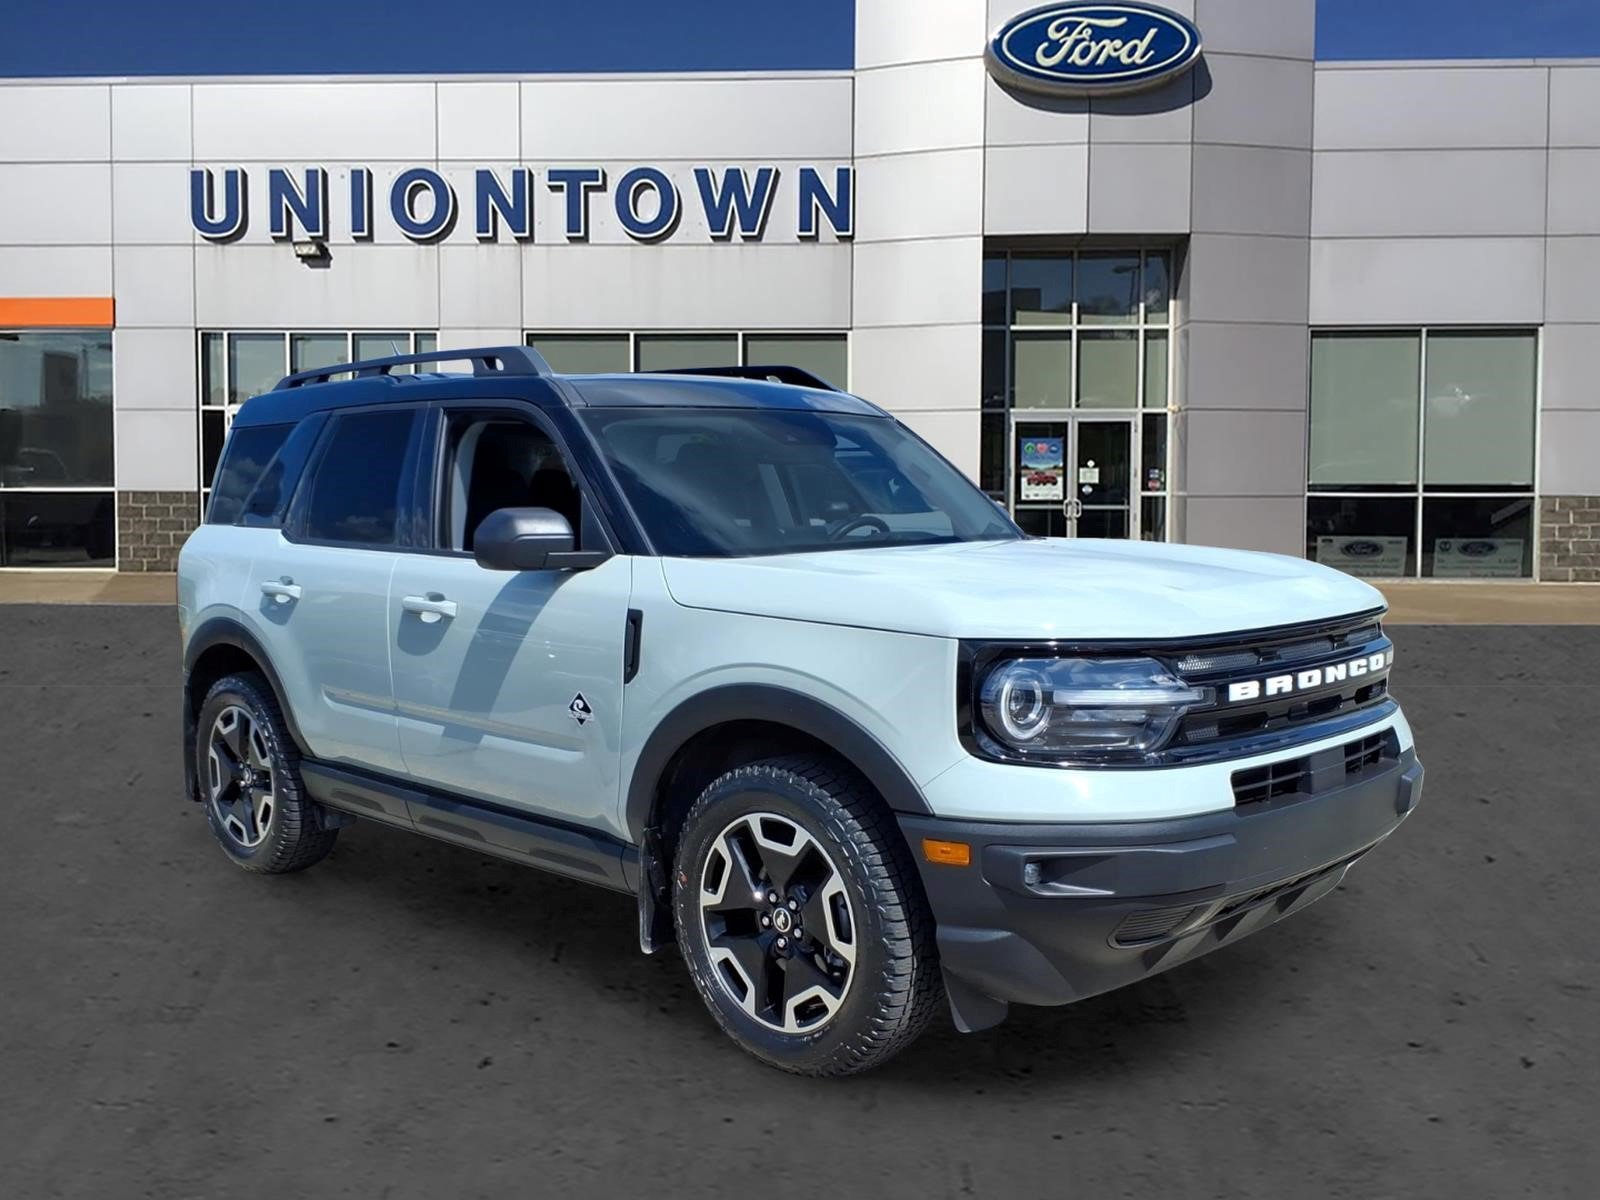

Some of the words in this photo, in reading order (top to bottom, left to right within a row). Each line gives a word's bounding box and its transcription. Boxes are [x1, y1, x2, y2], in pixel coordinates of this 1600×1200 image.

[1035, 16, 1158, 67] Ford
[189, 166, 854, 241] UNIONTOWN
[1228, 653, 1386, 702] BRONCO
